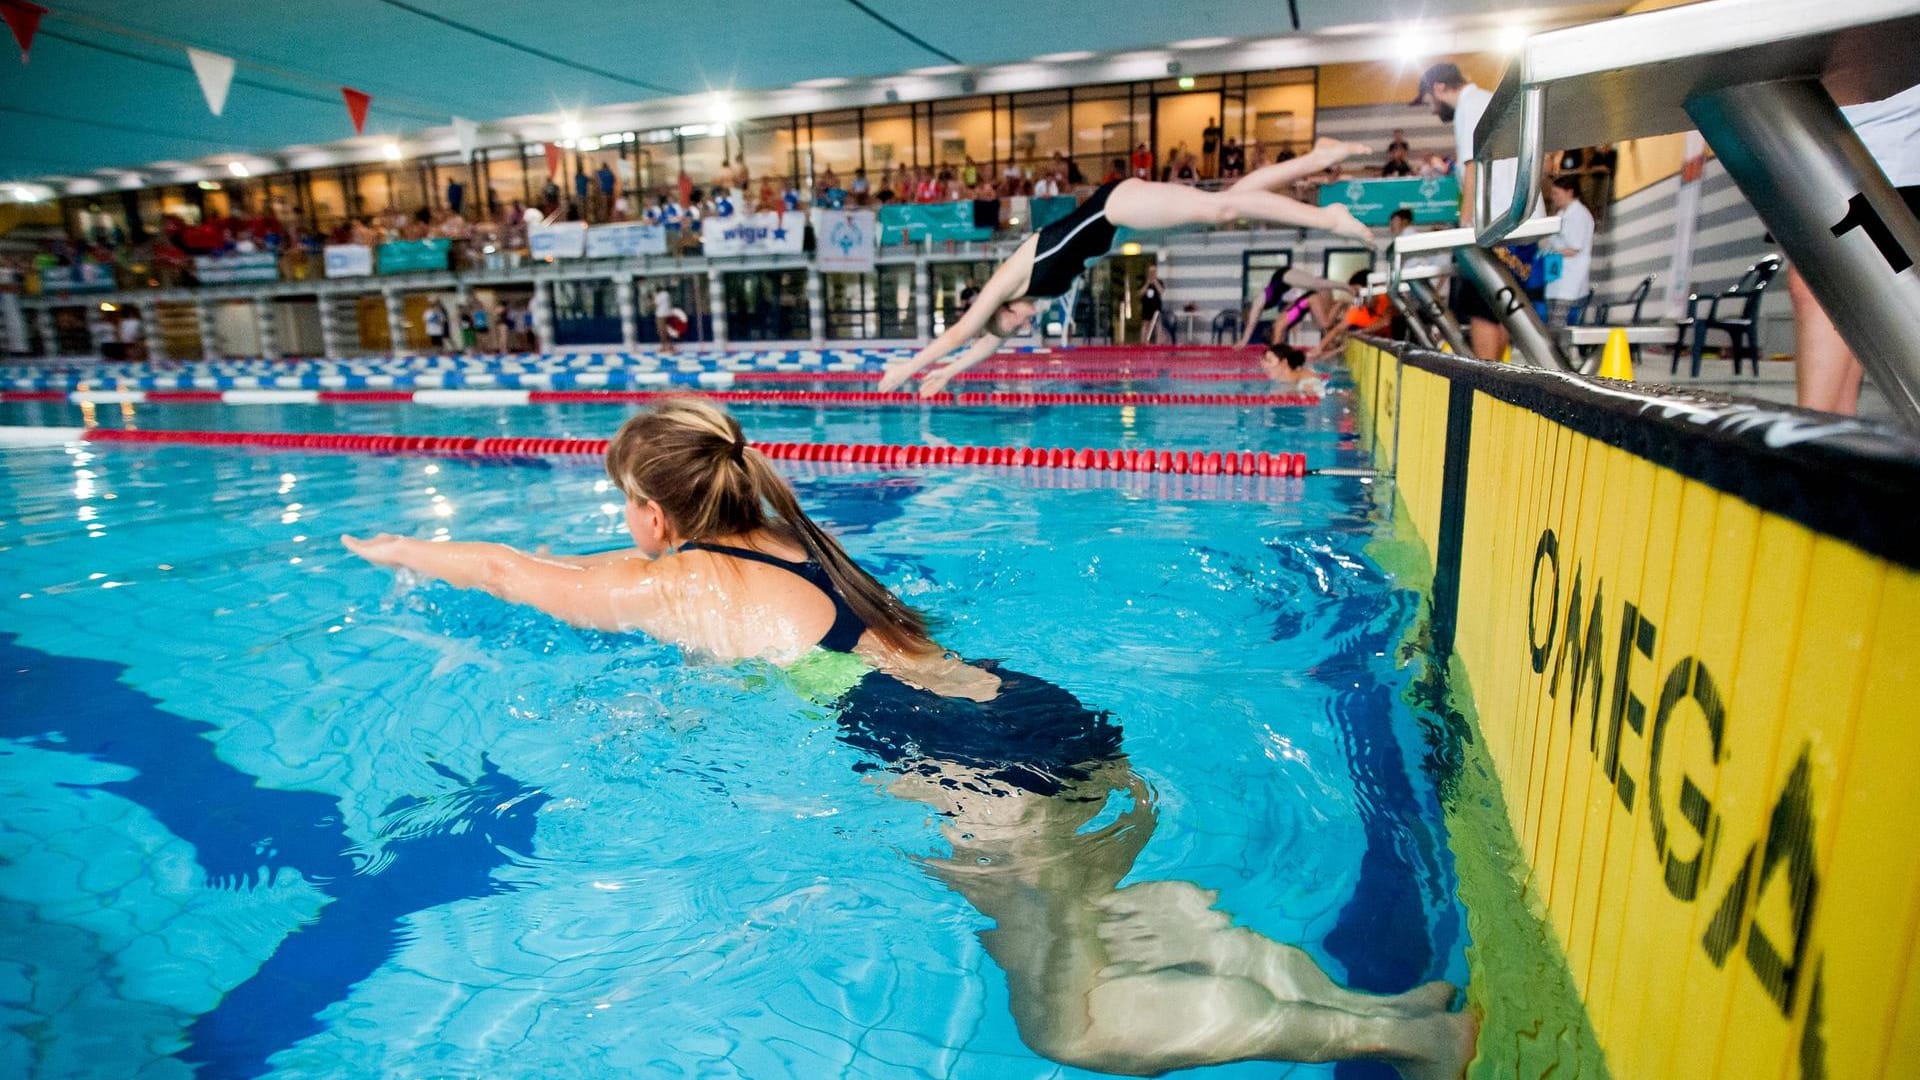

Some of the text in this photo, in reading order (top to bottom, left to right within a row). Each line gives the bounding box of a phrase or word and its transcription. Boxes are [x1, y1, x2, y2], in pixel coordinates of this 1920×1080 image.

[723, 226, 768, 244] wigu
[1829, 192, 1914, 274] 1
[1496, 287, 1524, 316] 2
[1528, 528, 1826, 1080] OMEGA
